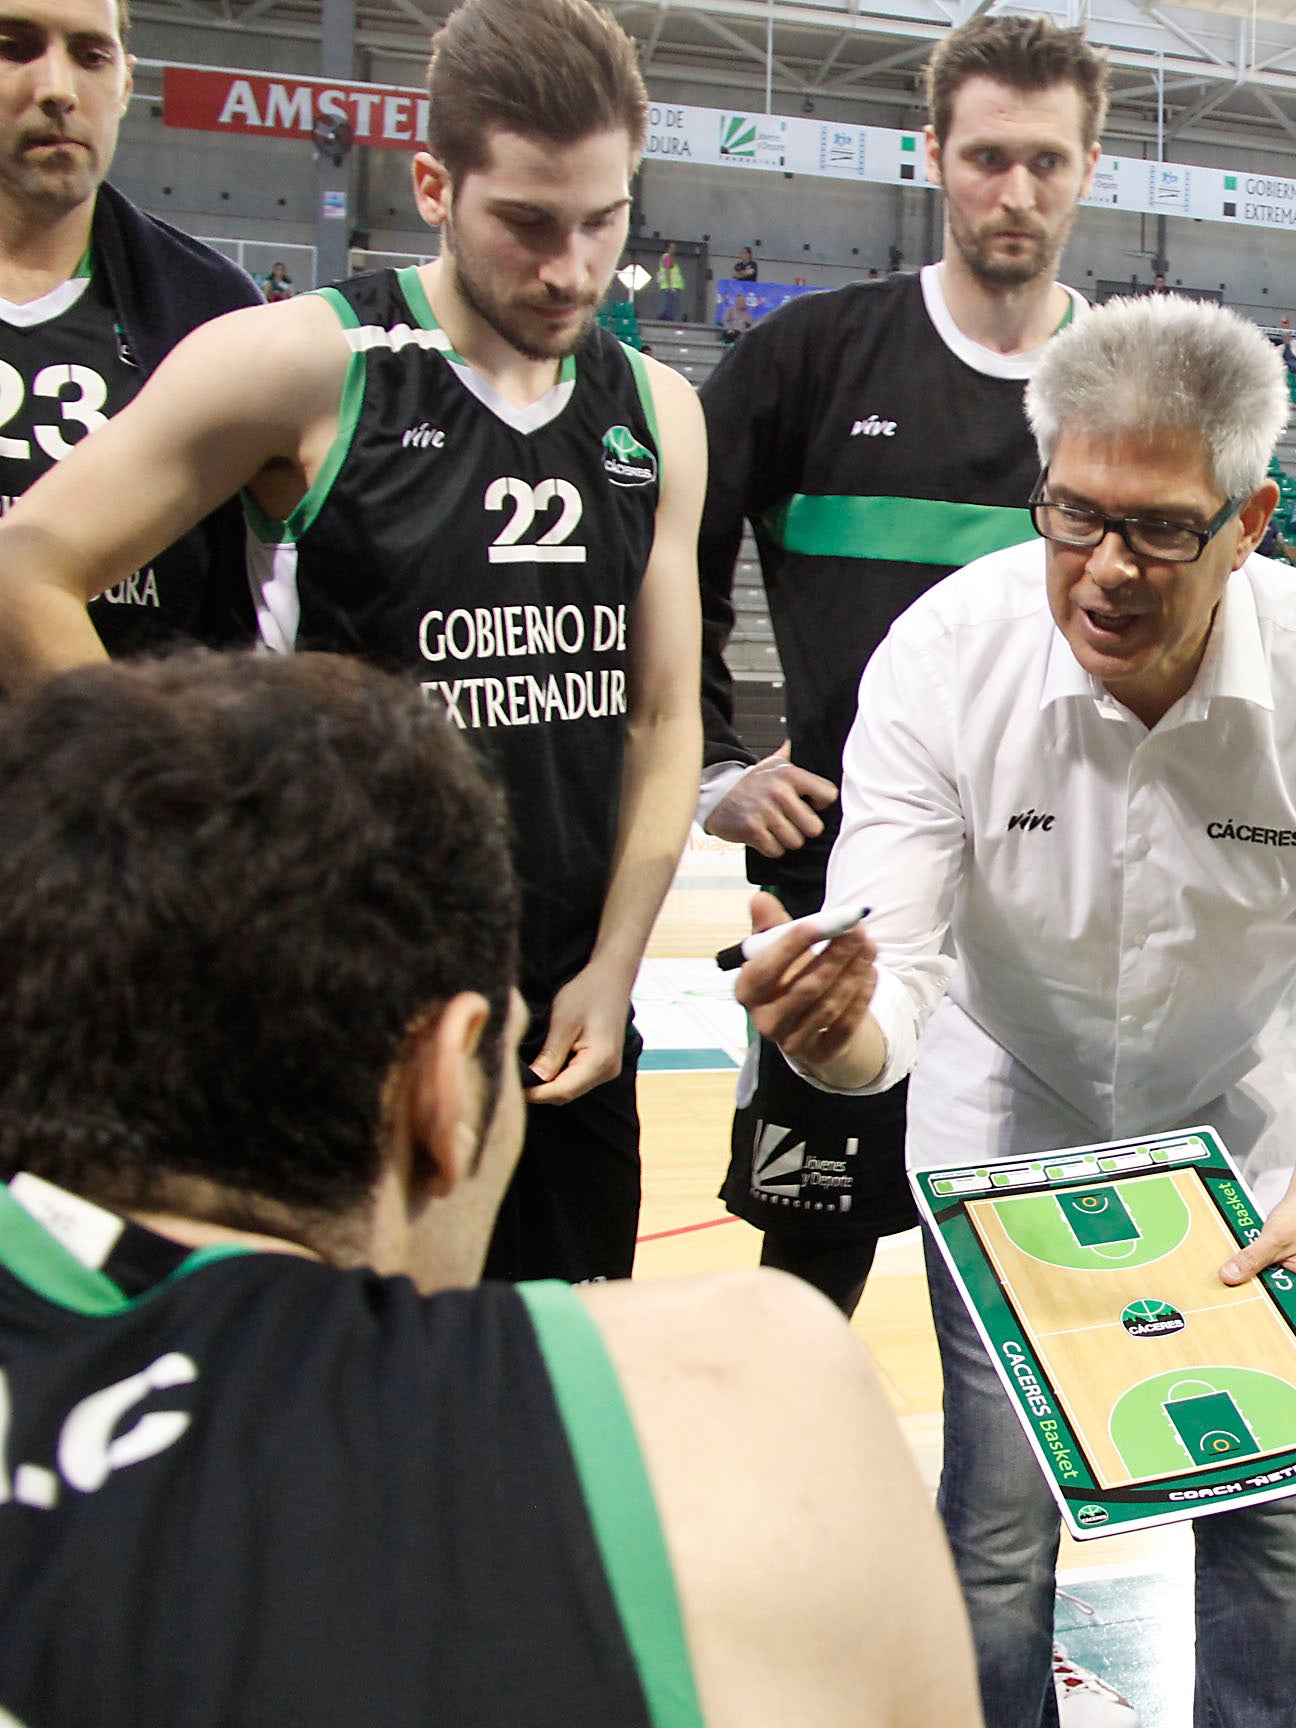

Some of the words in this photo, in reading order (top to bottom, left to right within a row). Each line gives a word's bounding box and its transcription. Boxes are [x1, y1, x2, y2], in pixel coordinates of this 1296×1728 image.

[484, 477, 587, 563] 22
[419, 604, 585, 661] GOBIERNO
[1218, 1182, 1254, 1226] Basket
[1128, 1318, 1184, 1335] CÁCERES
[1002, 1341, 1051, 1417] CACERES
[1040, 1419, 1078, 1479] Basket
[1168, 1482, 1242, 1501] COACH
